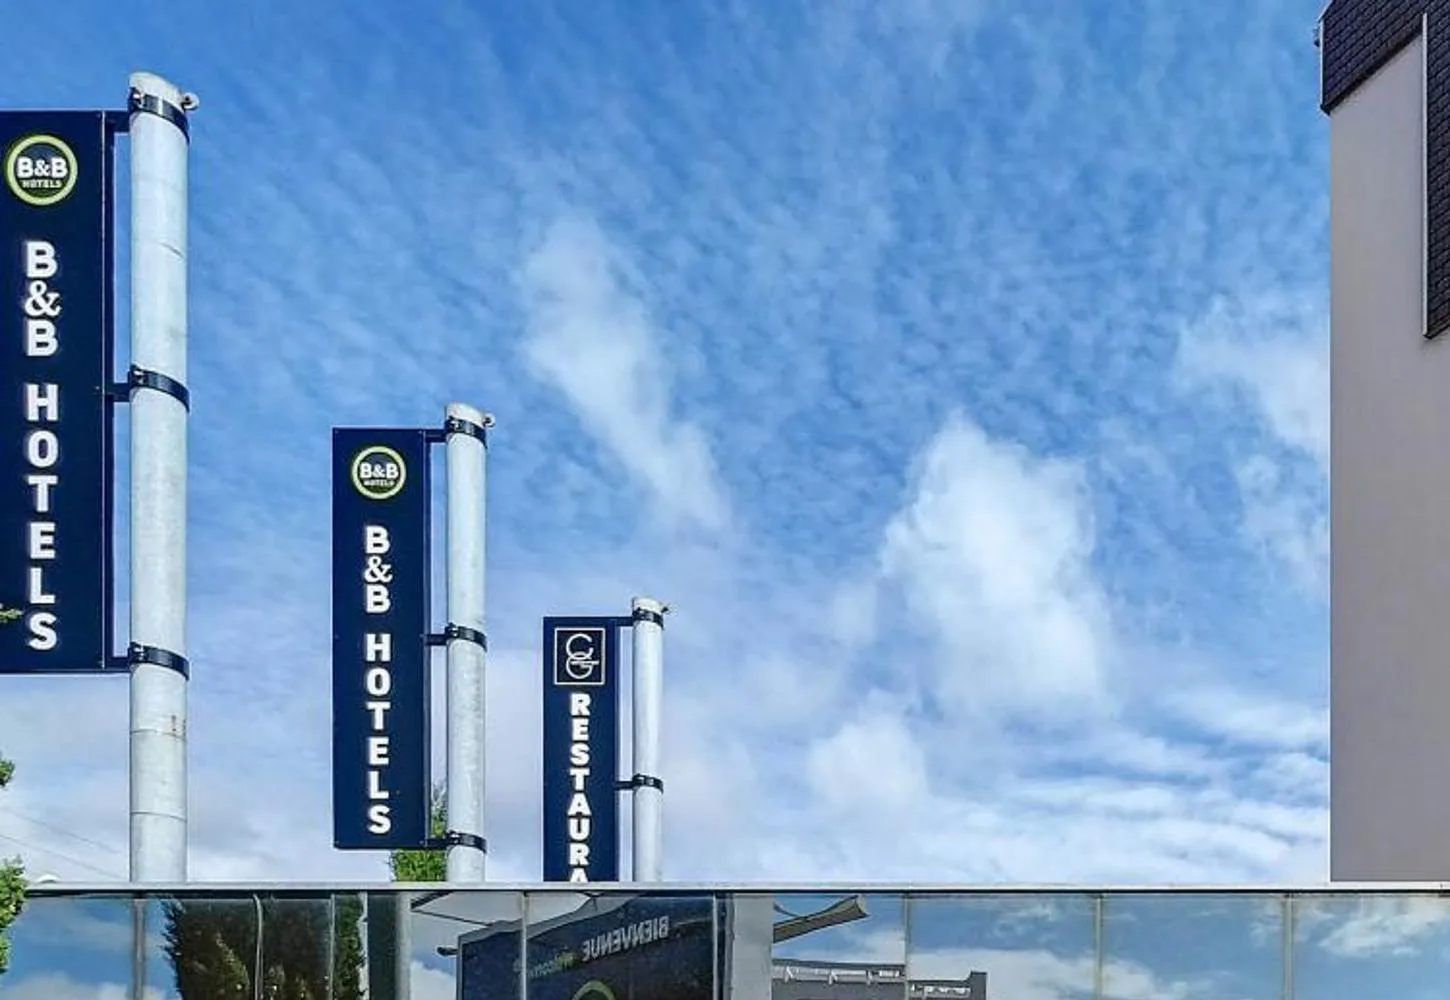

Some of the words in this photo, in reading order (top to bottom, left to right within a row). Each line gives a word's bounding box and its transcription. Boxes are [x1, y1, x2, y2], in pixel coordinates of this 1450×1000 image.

[17, 157, 68, 178] B&B
[21, 179, 62, 189] HOTELS
[24, 240, 61, 356] B&B
[359, 462, 399, 479] B&B
[26, 383, 59, 650] HOTELS
[364, 525, 393, 613] B&B
[365, 633, 392, 834] HOTELS
